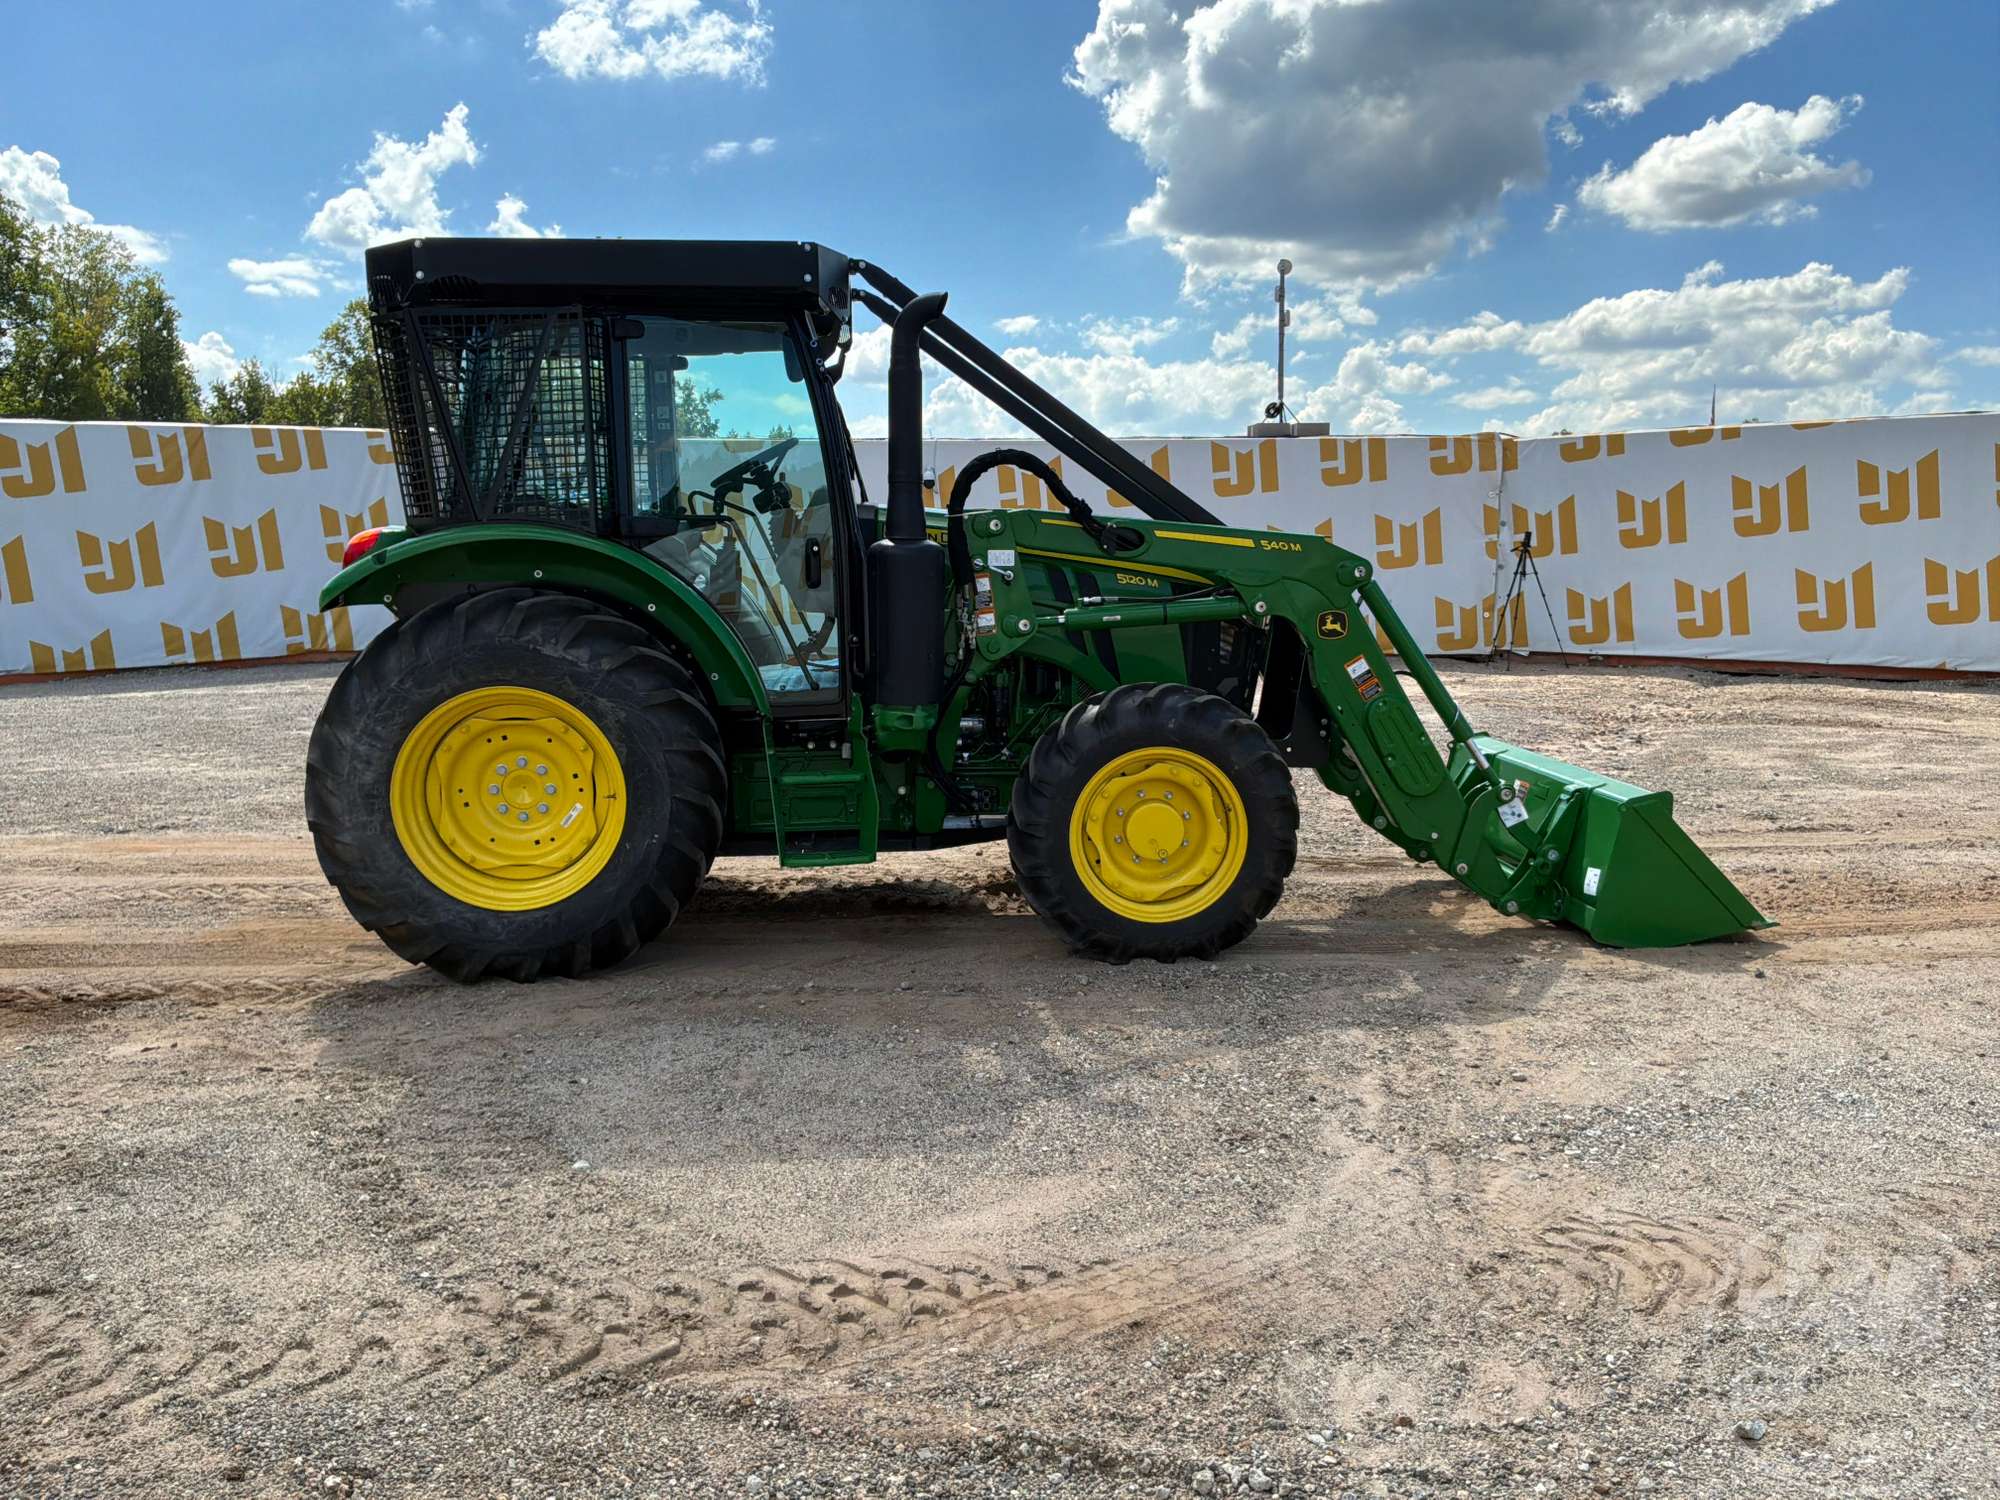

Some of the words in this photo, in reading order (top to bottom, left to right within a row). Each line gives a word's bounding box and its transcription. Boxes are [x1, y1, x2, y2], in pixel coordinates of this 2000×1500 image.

[1260, 540, 1288, 551] 540
[1289, 543, 1302, 552] M
[1116, 573, 1145, 585] 5120
[1146, 579, 1159, 588] M
